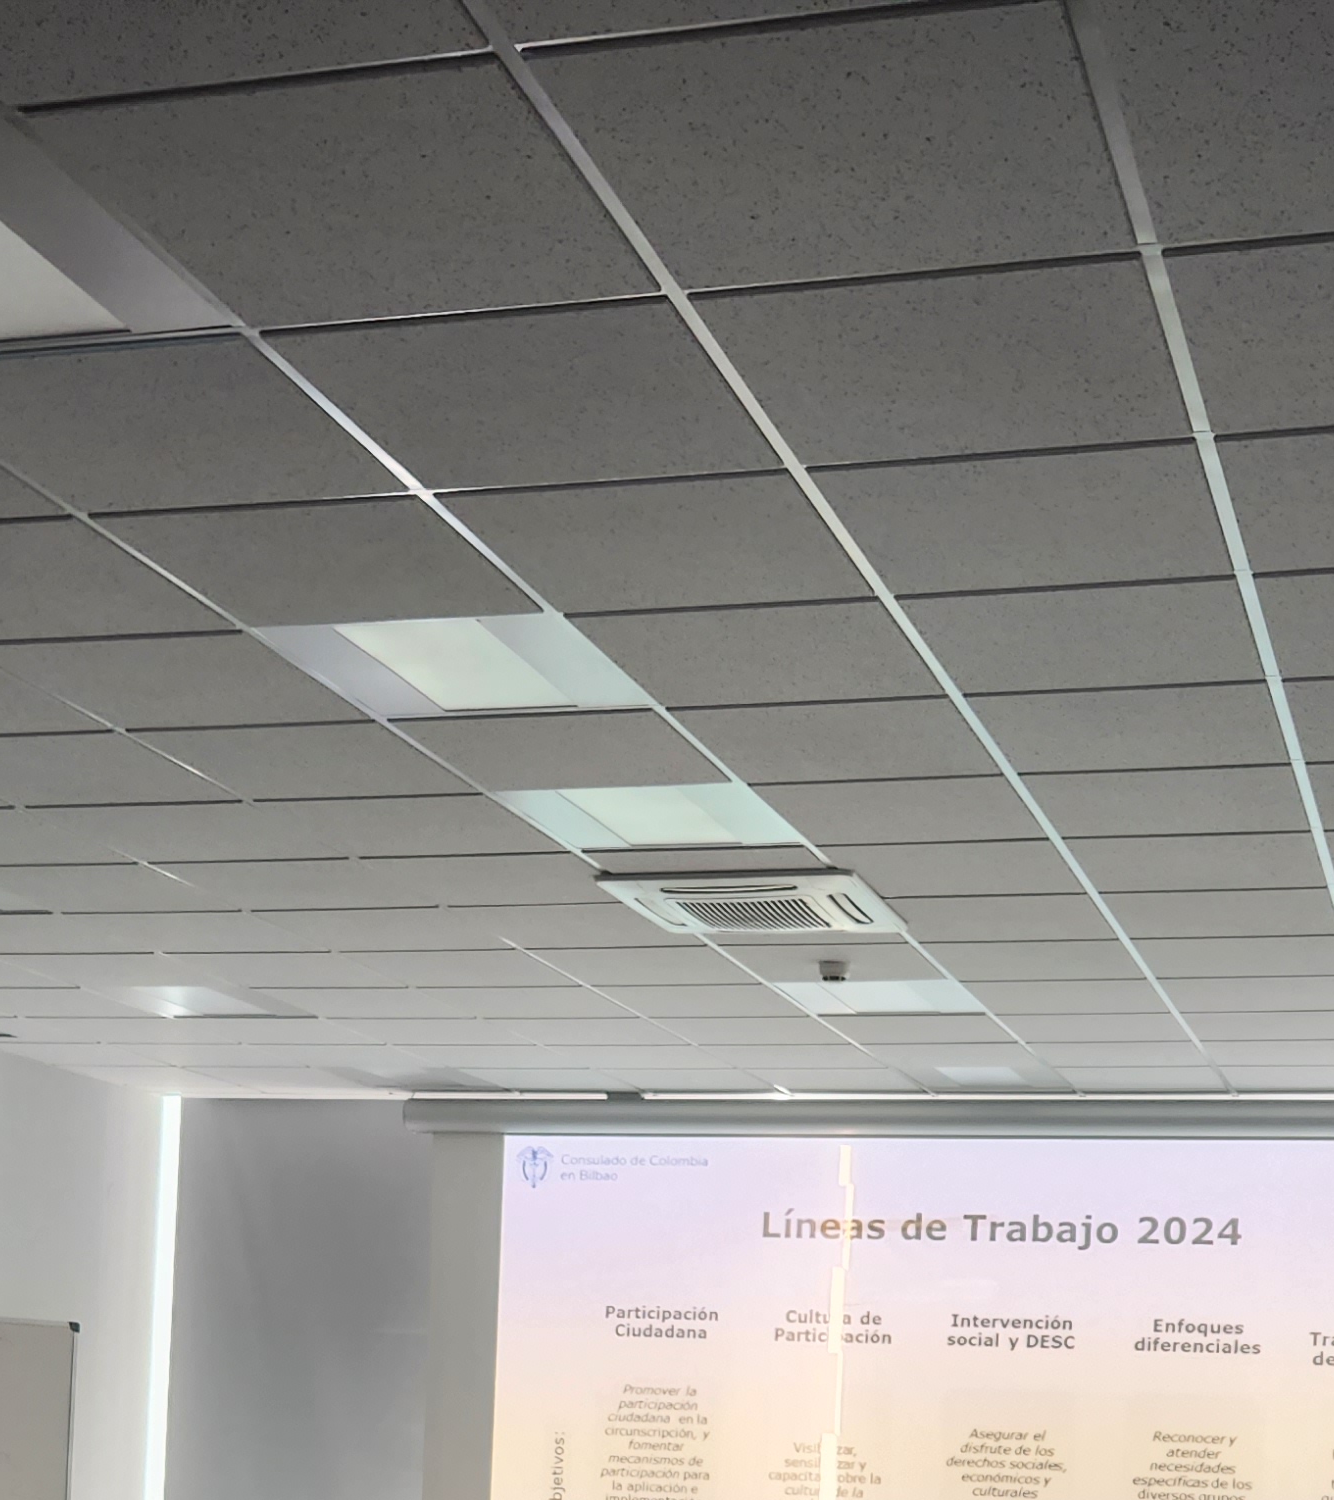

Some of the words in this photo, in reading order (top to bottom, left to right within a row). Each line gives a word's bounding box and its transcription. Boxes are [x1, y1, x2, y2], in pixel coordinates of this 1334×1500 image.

[561, 1154, 627, 1166] Consulado
[630, 1154, 646, 1166] de
[649, 1154, 708, 1167] Colombia
[560, 1171, 576, 1180] en
[579, 1169, 618, 1181] Bilbao
[761, 1208, 886, 1241] Líneas
[901, 1213, 947, 1241] de
[963, 1214, 1119, 1250] Trabajo
[1137, 1216, 1242, 1246] 2024
[605, 1305, 719, 1323] Participación
[786, 1309, 852, 1325] Cultua
[860, 1311, 882, 1325] de
[951, 1314, 1073, 1331] Intervención
[1153, 1319, 1244, 1337] Enfoques
[615, 1323, 708, 1339] Ciudadana
[774, 1327, 892, 1344] Particación
[947, 1332, 999, 1347] social
[1009, 1337, 1019, 1351] y
[1026, 1335, 1075, 1350] DESC
[1134, 1337, 1261, 1355] diferenciales
[623, 1384, 680, 1396] Promover
[686, 1386, 697, 1396] la
[618, 1399, 698, 1411] participación
[608, 1413, 671, 1424] ciudadana
[679, 1415, 693, 1424] en
[697, 1414, 708, 1425] la
[703, 1431, 710, 1440] y
[969, 1429, 1028, 1442] Asegurar
[1033, 1431, 1046, 1441] el
[1152, 1431, 1225, 1445] Reconocer
[1228, 1436, 1237, 1447] y
[628, 1439, 684, 1451] fomentar
[960, 1443, 1011, 1455] disfrute
[1014, 1444, 1032, 1456] de
[1035, 1446, 1055, 1457] los
[608, 1454, 685, 1466] mecanismos
[688, 1456, 704, 1467] de
[1166, 1448, 1222, 1460] atender
[859, 1462, 866, 1471] y
[946, 1456, 1006, 1469] derechos
[1009, 1460, 1067, 1473] sociales,
[1150, 1461, 1236, 1475] necesidades
[600, 1468, 680, 1479] participación
[683, 1471, 710, 1481] para
[870, 1472, 882, 1485] la
[961, 1472, 1041, 1485] económicos
[1043, 1478, 1051, 1488] y
[612, 1480, 622, 1491] la
[627, 1481, 688, 1494] aplicación
[691, 1485, 698, 1494] e
[1132, 1475, 1208, 1488] específicas
[1211, 1478, 1229, 1490] de
[1232, 1478, 1253, 1491] los
[852, 1487, 864, 1498] la
[972, 1486, 1038, 1499] culturales
